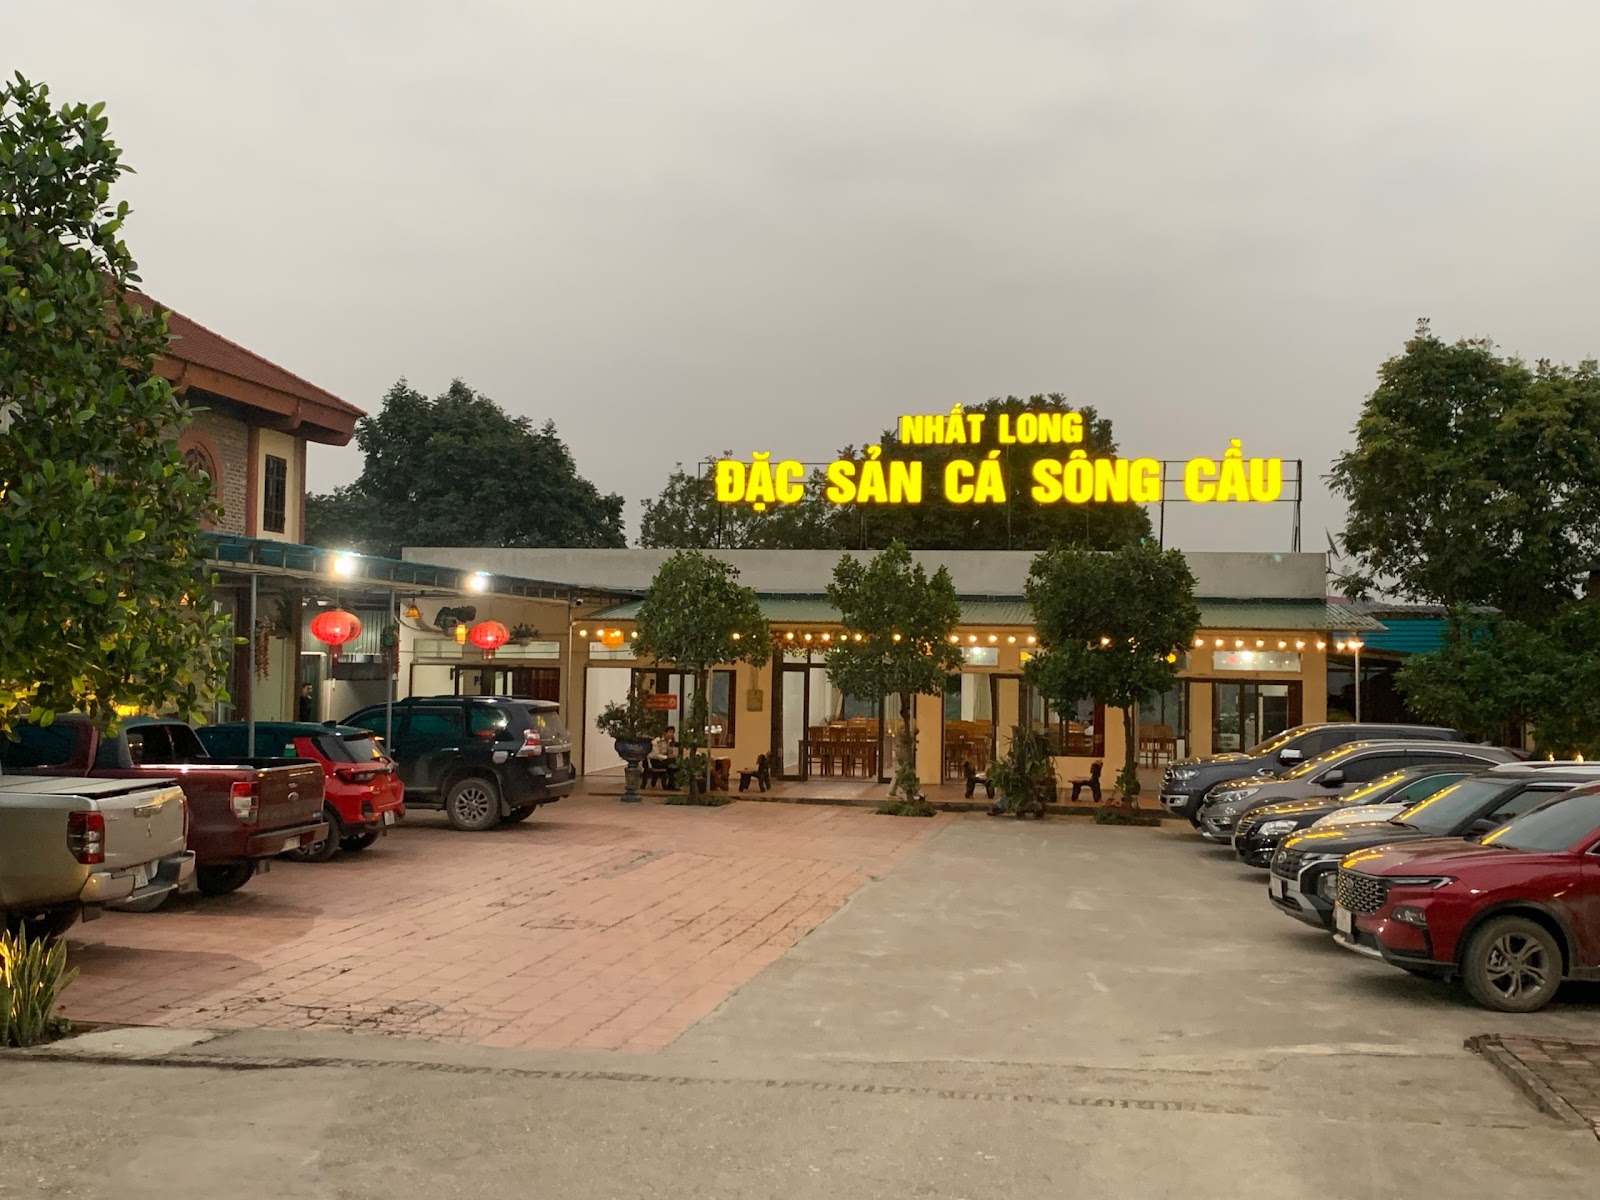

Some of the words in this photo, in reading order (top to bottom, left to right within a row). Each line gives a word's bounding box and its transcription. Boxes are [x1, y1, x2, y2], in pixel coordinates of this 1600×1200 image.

[900, 403, 985, 444] NHẤT
[999, 412, 1083, 444] LONG
[715, 451, 805, 512] ĐẶC
[825, 444, 923, 505] SẢN
[945, 449, 1007, 505] CÁ
[1031, 449, 1163, 505] SÔNG
[1183, 438, 1283, 505] CẦU
